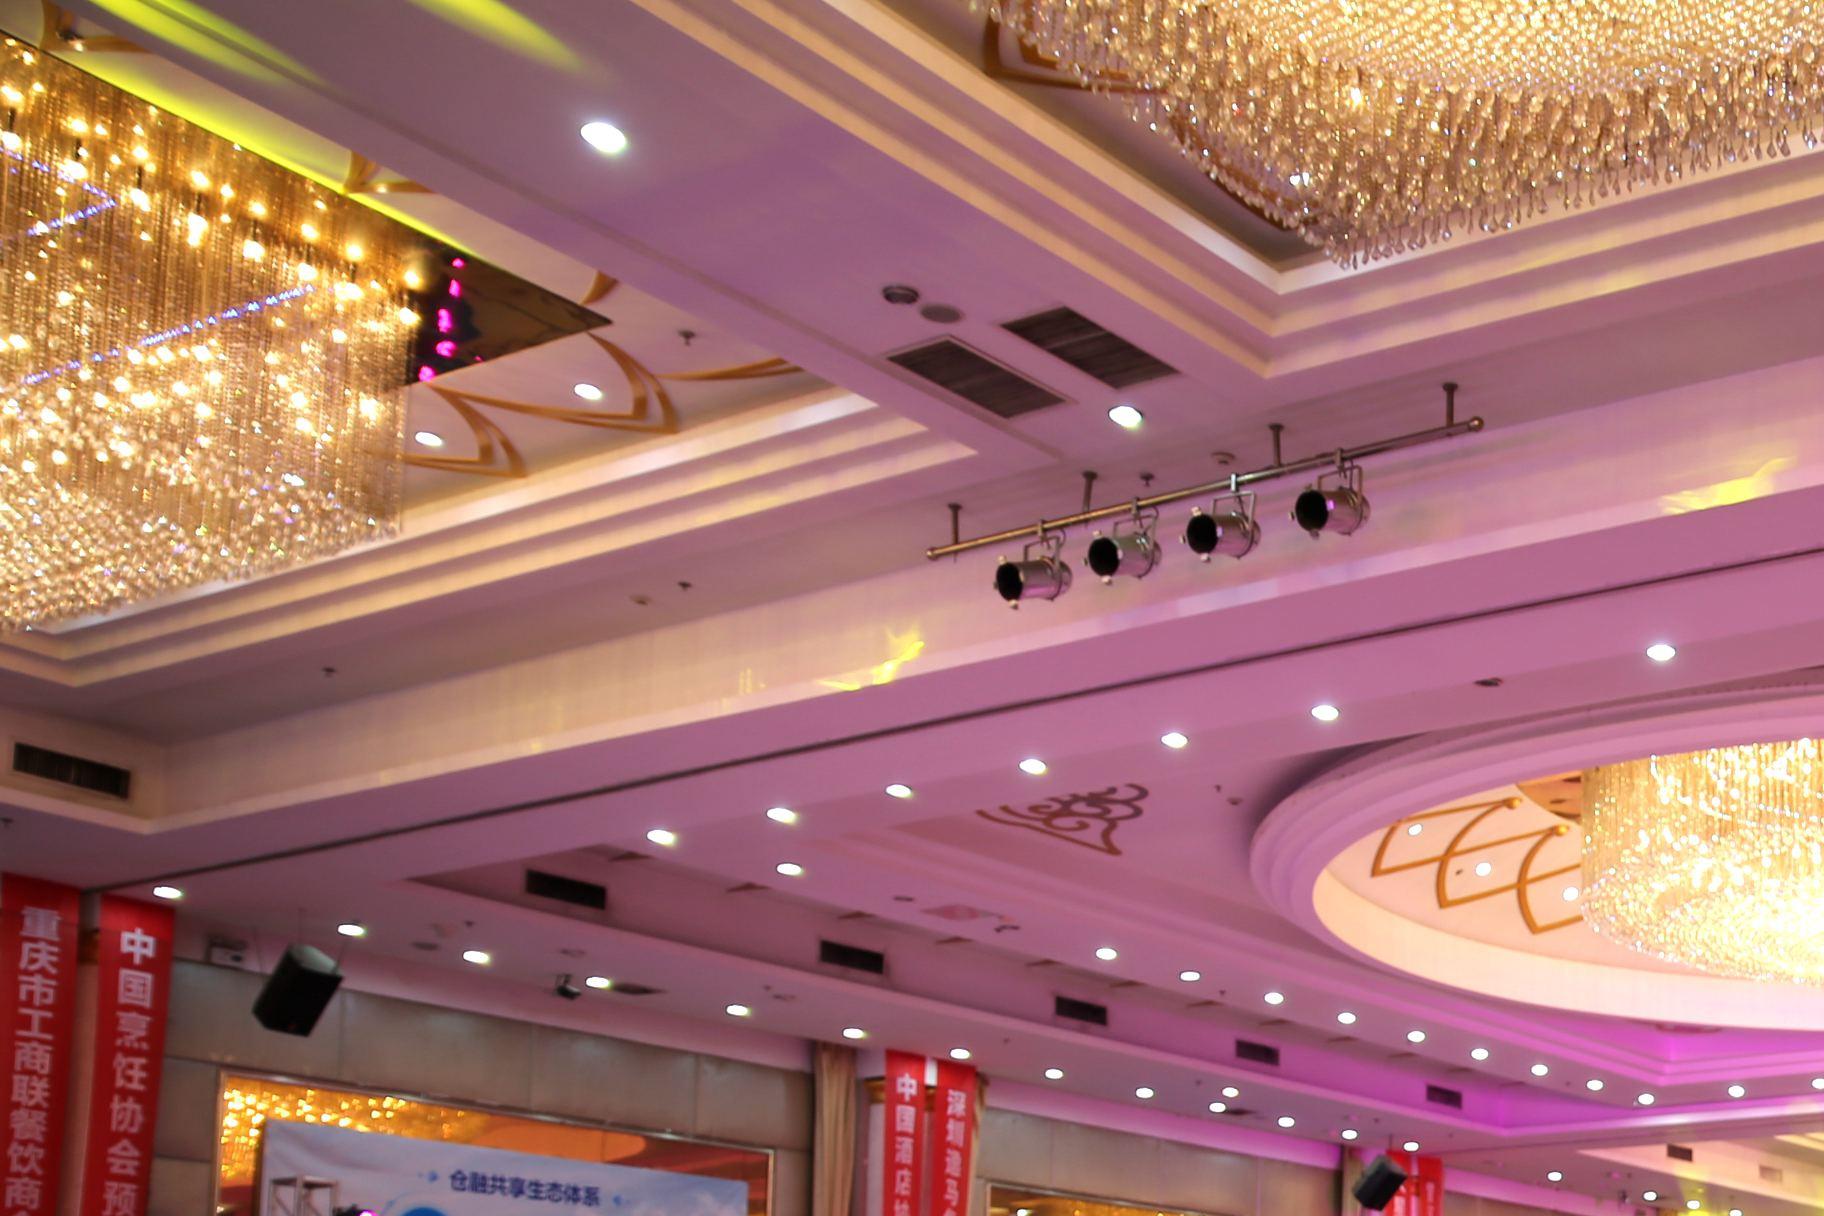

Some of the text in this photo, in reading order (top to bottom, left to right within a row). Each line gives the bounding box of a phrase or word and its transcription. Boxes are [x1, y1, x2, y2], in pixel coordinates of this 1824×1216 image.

[449, 1169, 601, 1207] 仓融共享生态体系
